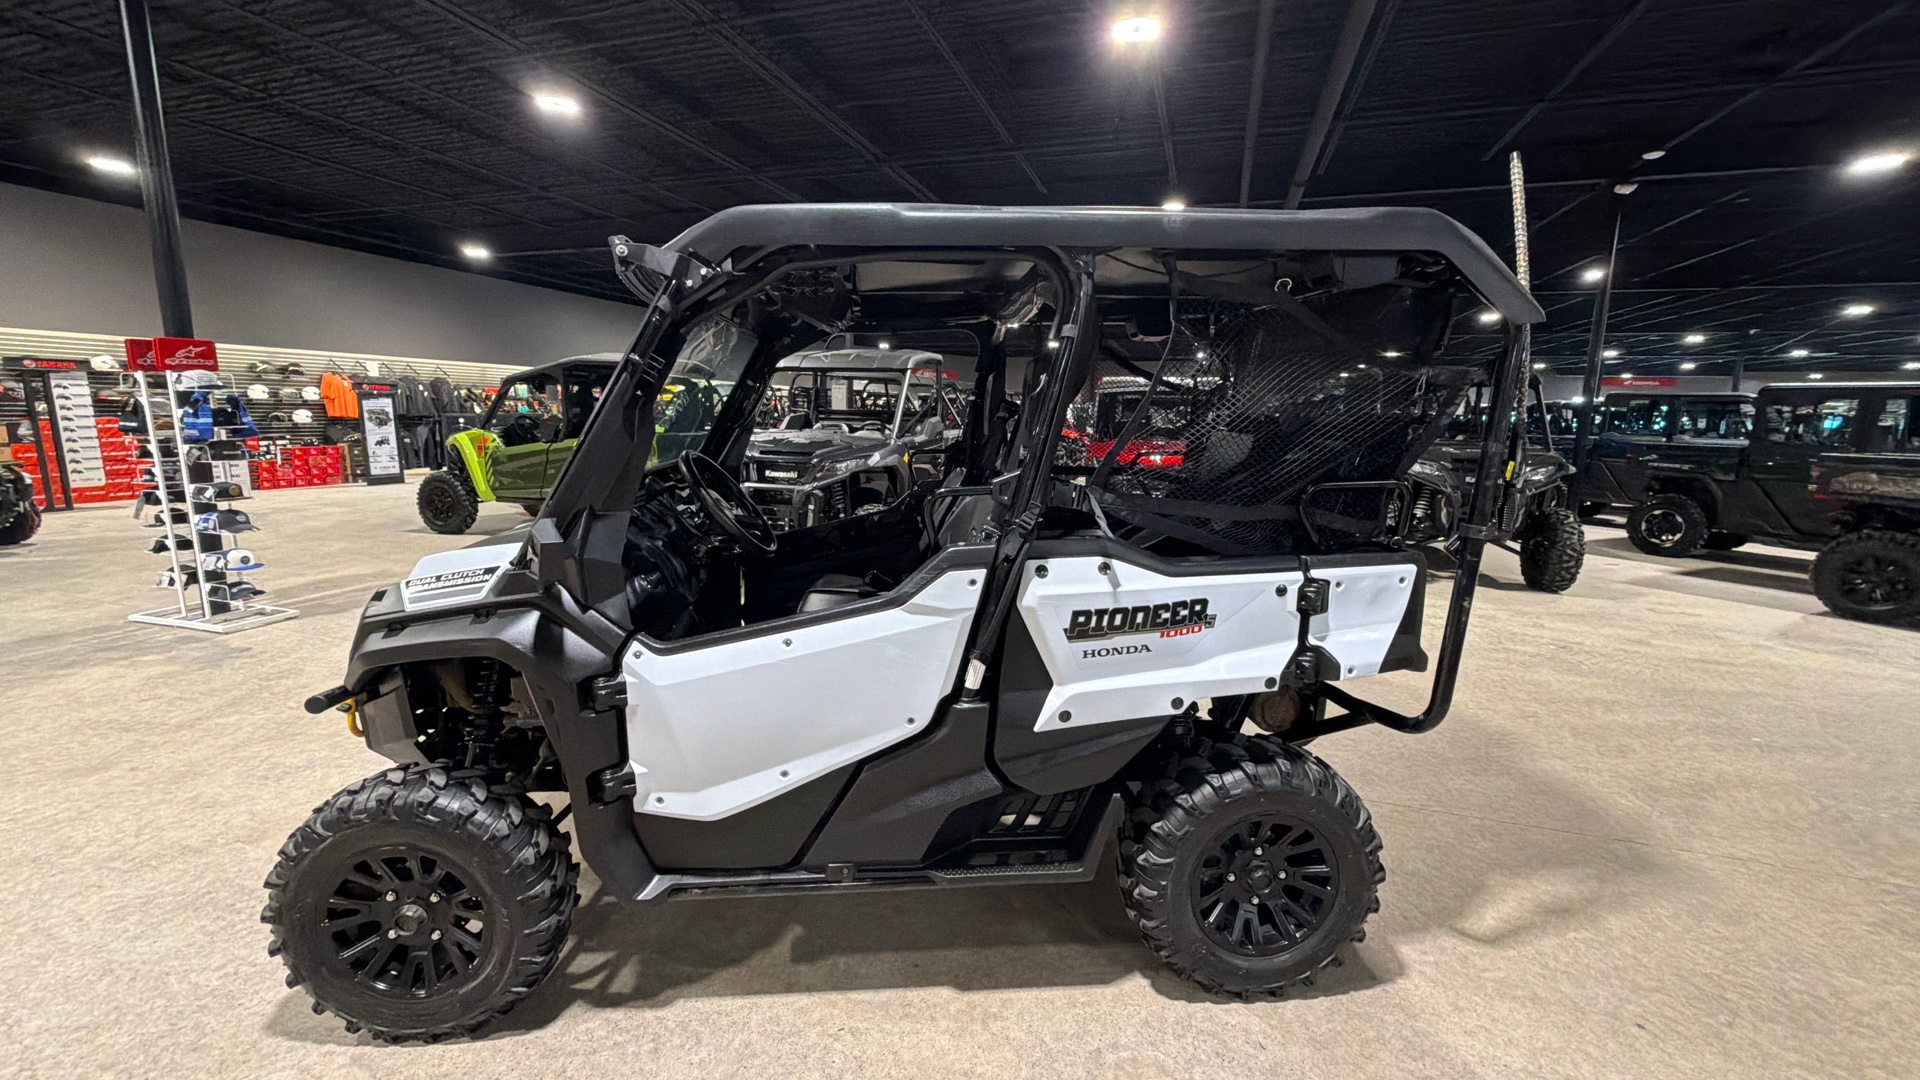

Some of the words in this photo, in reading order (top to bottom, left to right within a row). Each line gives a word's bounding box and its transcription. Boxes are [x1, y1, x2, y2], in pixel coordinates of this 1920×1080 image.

[765, 469, 798, 478] Kawasaki
[408, 576, 437, 586] DUAL
[440, 568, 485, 580] CLUTCH
[1067, 598, 1210, 636] PIONEER
[1159, 624, 1204, 639] 1000
[1082, 644, 1152, 659] HONDA
